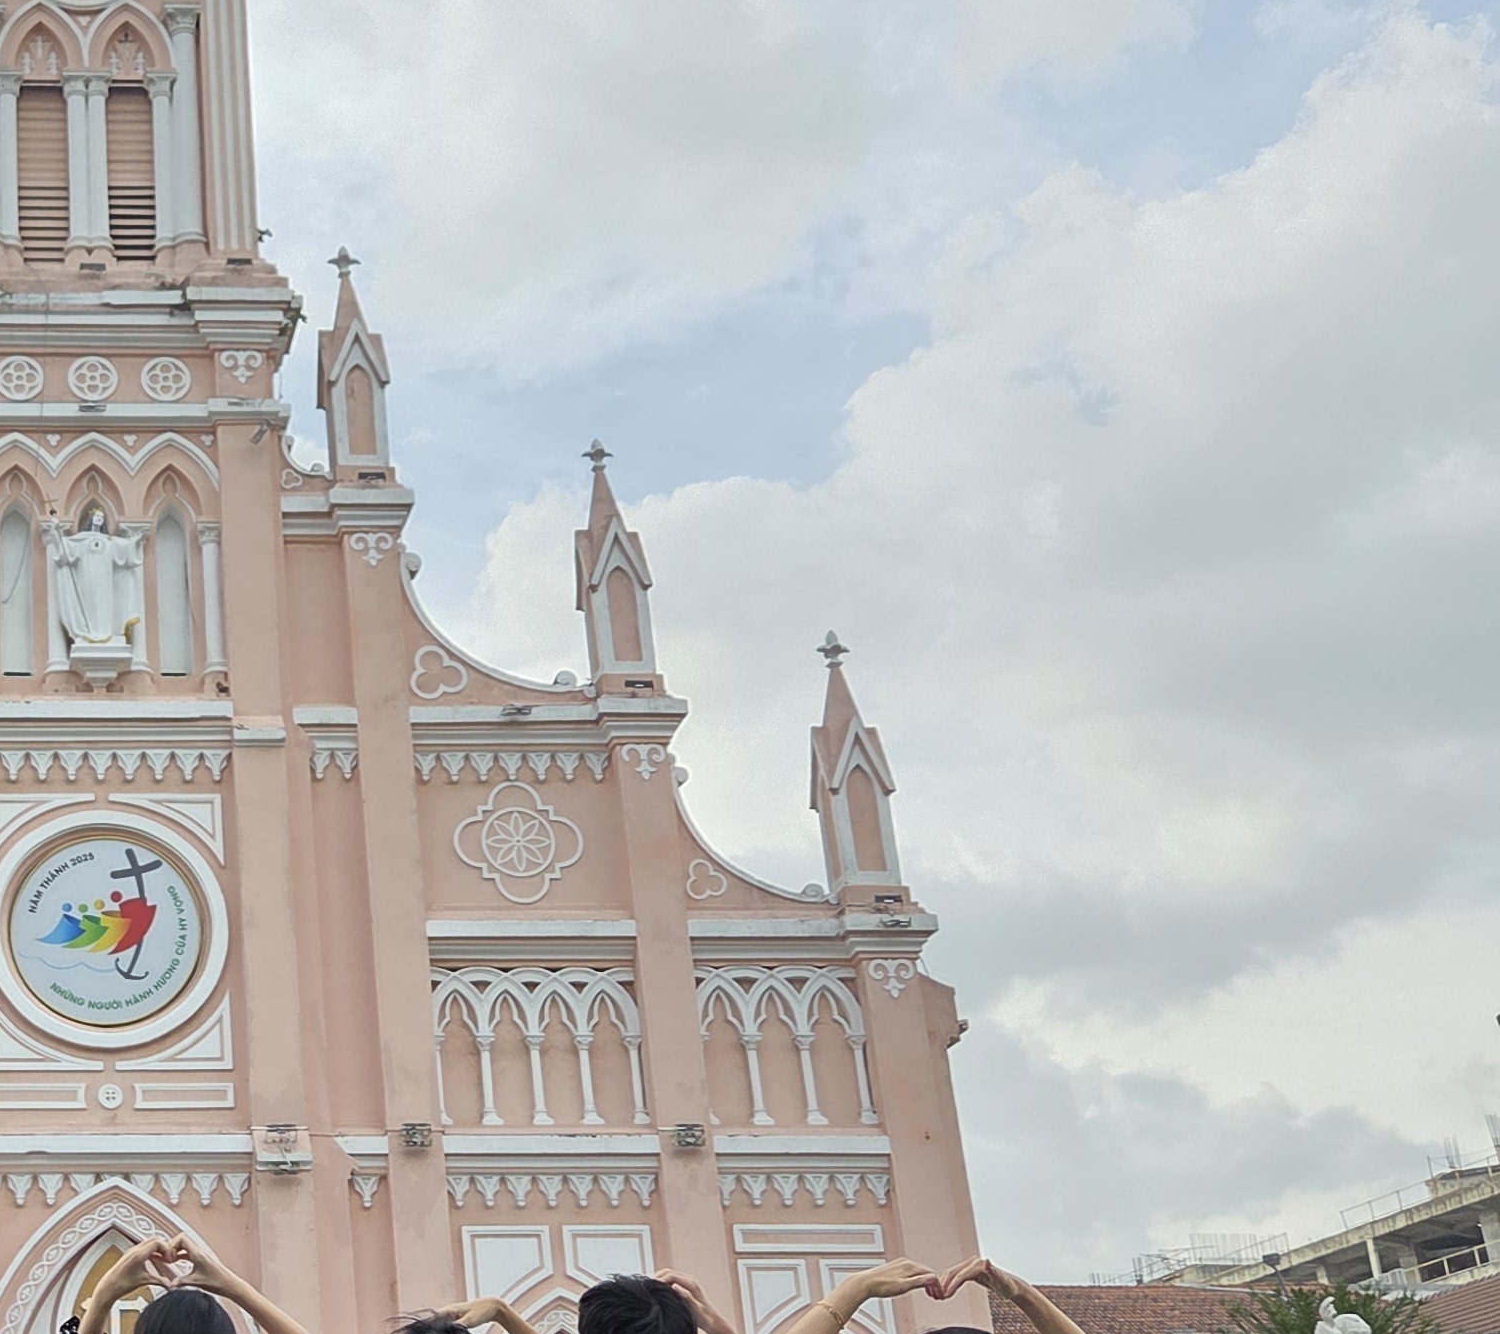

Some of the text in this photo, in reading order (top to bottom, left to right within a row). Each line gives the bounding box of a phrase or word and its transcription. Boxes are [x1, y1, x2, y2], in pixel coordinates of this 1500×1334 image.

[39, 861, 71, 889] THÁNH
[69, 851, 95, 867] 2025
[177, 917, 189, 931] HY
[174, 934, 188, 956] CỦA
[124, 987, 155, 1007] HÀNH
